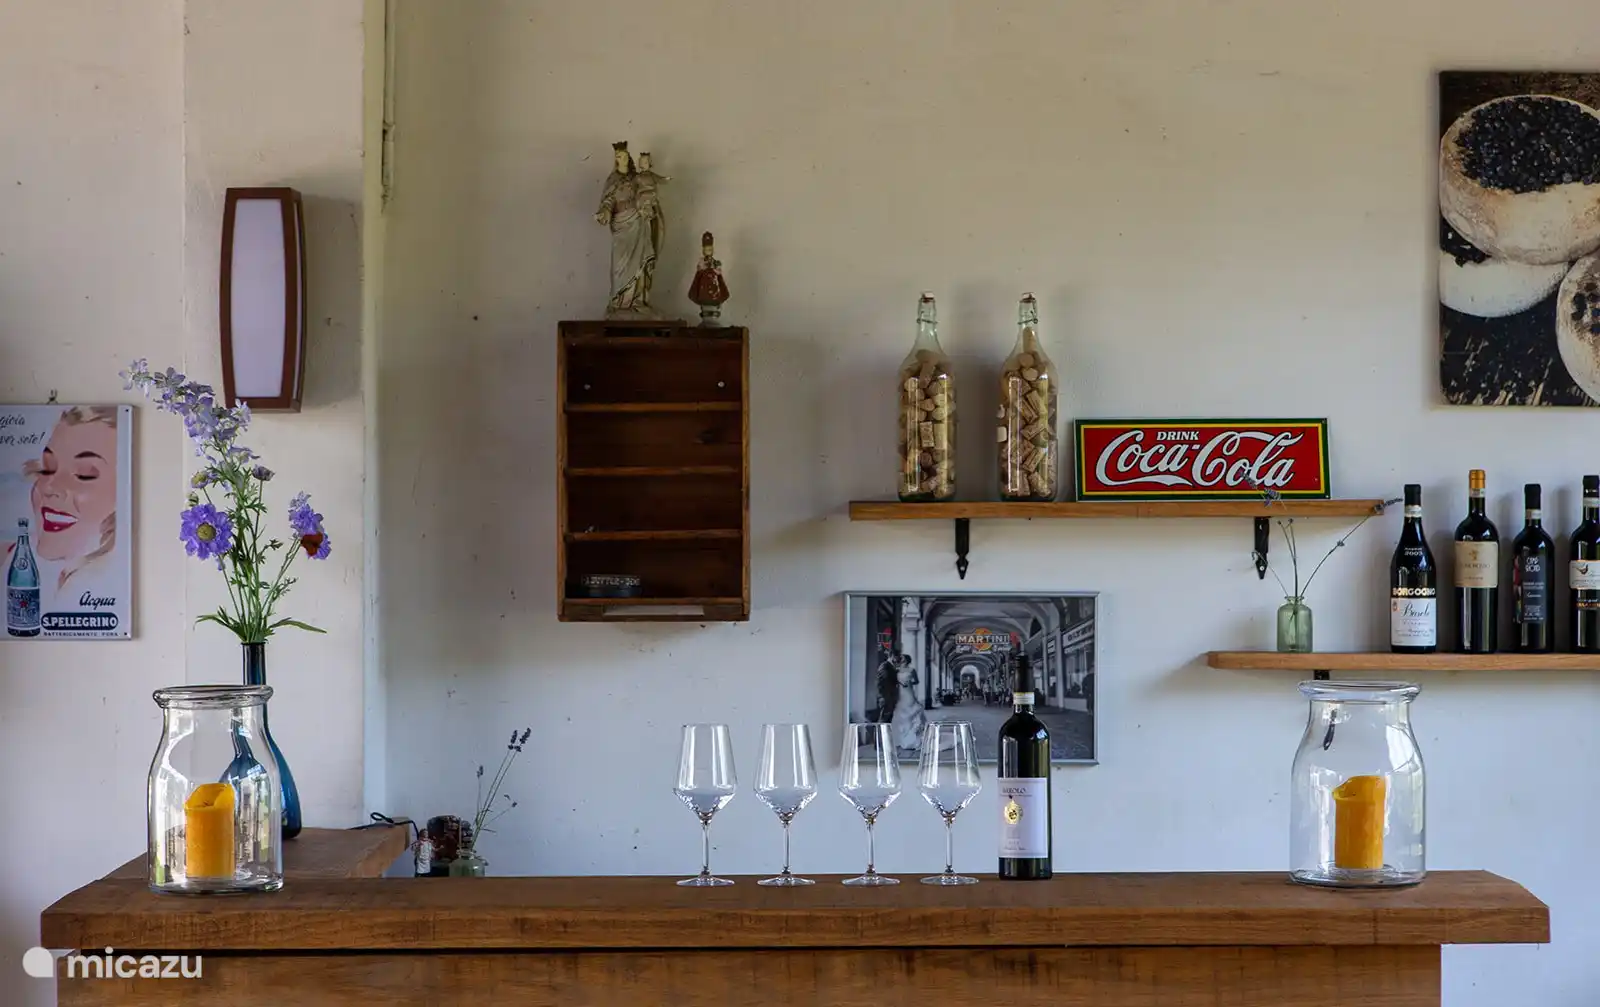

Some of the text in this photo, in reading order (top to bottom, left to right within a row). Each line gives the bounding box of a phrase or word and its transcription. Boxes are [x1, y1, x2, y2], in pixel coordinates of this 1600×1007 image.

[17, 431, 46, 446] sete!
[1156, 430, 1200, 442] DRINK
[1095, 429, 1304, 488] Coca-Cola
[79, 590, 117, 611] Acqua
[42, 616, 118, 628] S.PELLEGRINO
[958, 635, 1007, 644] MARTINI
